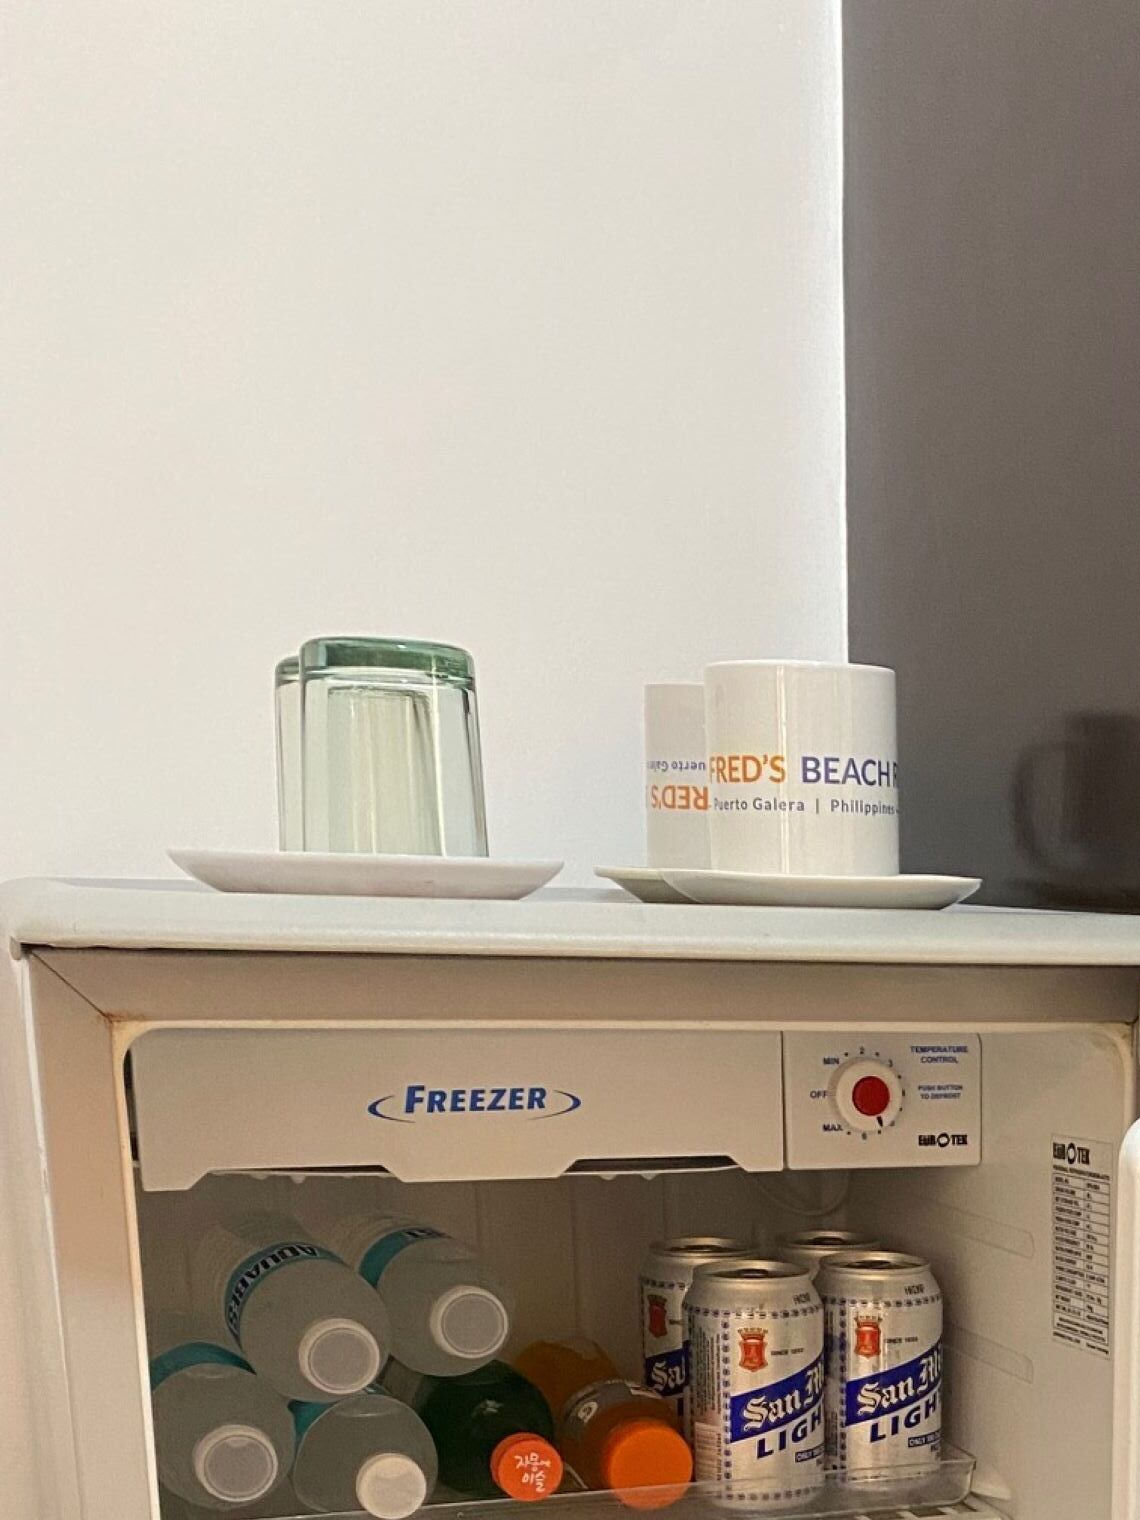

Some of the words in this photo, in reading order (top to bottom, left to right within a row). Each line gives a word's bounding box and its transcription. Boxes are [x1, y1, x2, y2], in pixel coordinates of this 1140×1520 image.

[670, 760, 706, 772] uerto
[709, 754, 787, 784] FRED'S
[650, 785, 711, 811] RED'S
[714, 797, 749, 812] Puerto
[752, 797, 806, 813] Galera
[910, 1045, 969, 1054] TEMPERATURE
[823, 1056, 840, 1067] MIN
[920, 1055, 960, 1065] CONTROL
[404, 1084, 547, 1115] FREEZER
[809, 1090, 829, 1100] OFF
[822, 1123, 844, 1133] MAX
[857, 1376, 915, 1417] San
[743, 1387, 801, 1433] San
[521, 1470, 546, 1494] 이슬
